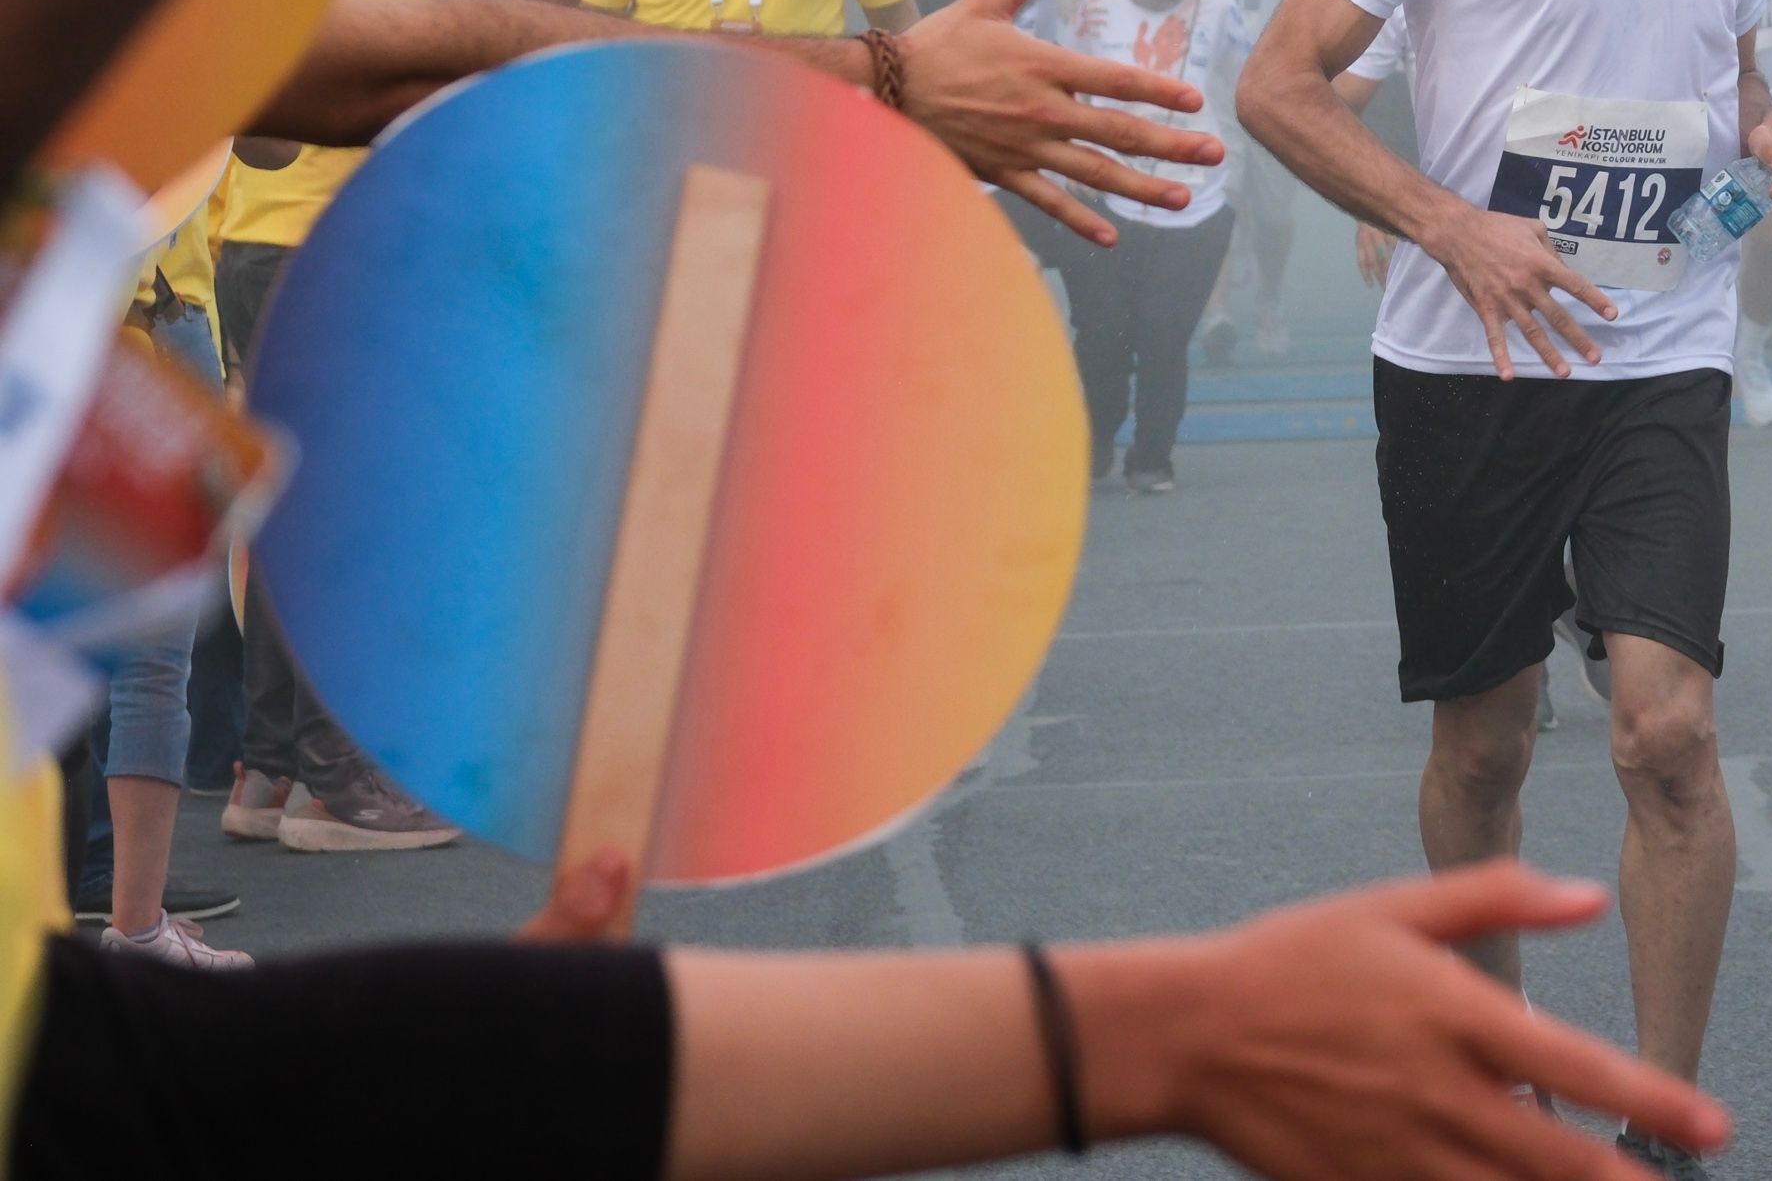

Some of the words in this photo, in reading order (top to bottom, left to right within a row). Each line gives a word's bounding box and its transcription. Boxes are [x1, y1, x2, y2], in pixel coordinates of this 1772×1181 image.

[1588, 125, 1666, 141] İSTANBULU
[1602, 155, 1636, 163] COLOUR
[1538, 165, 1667, 241] 5412
